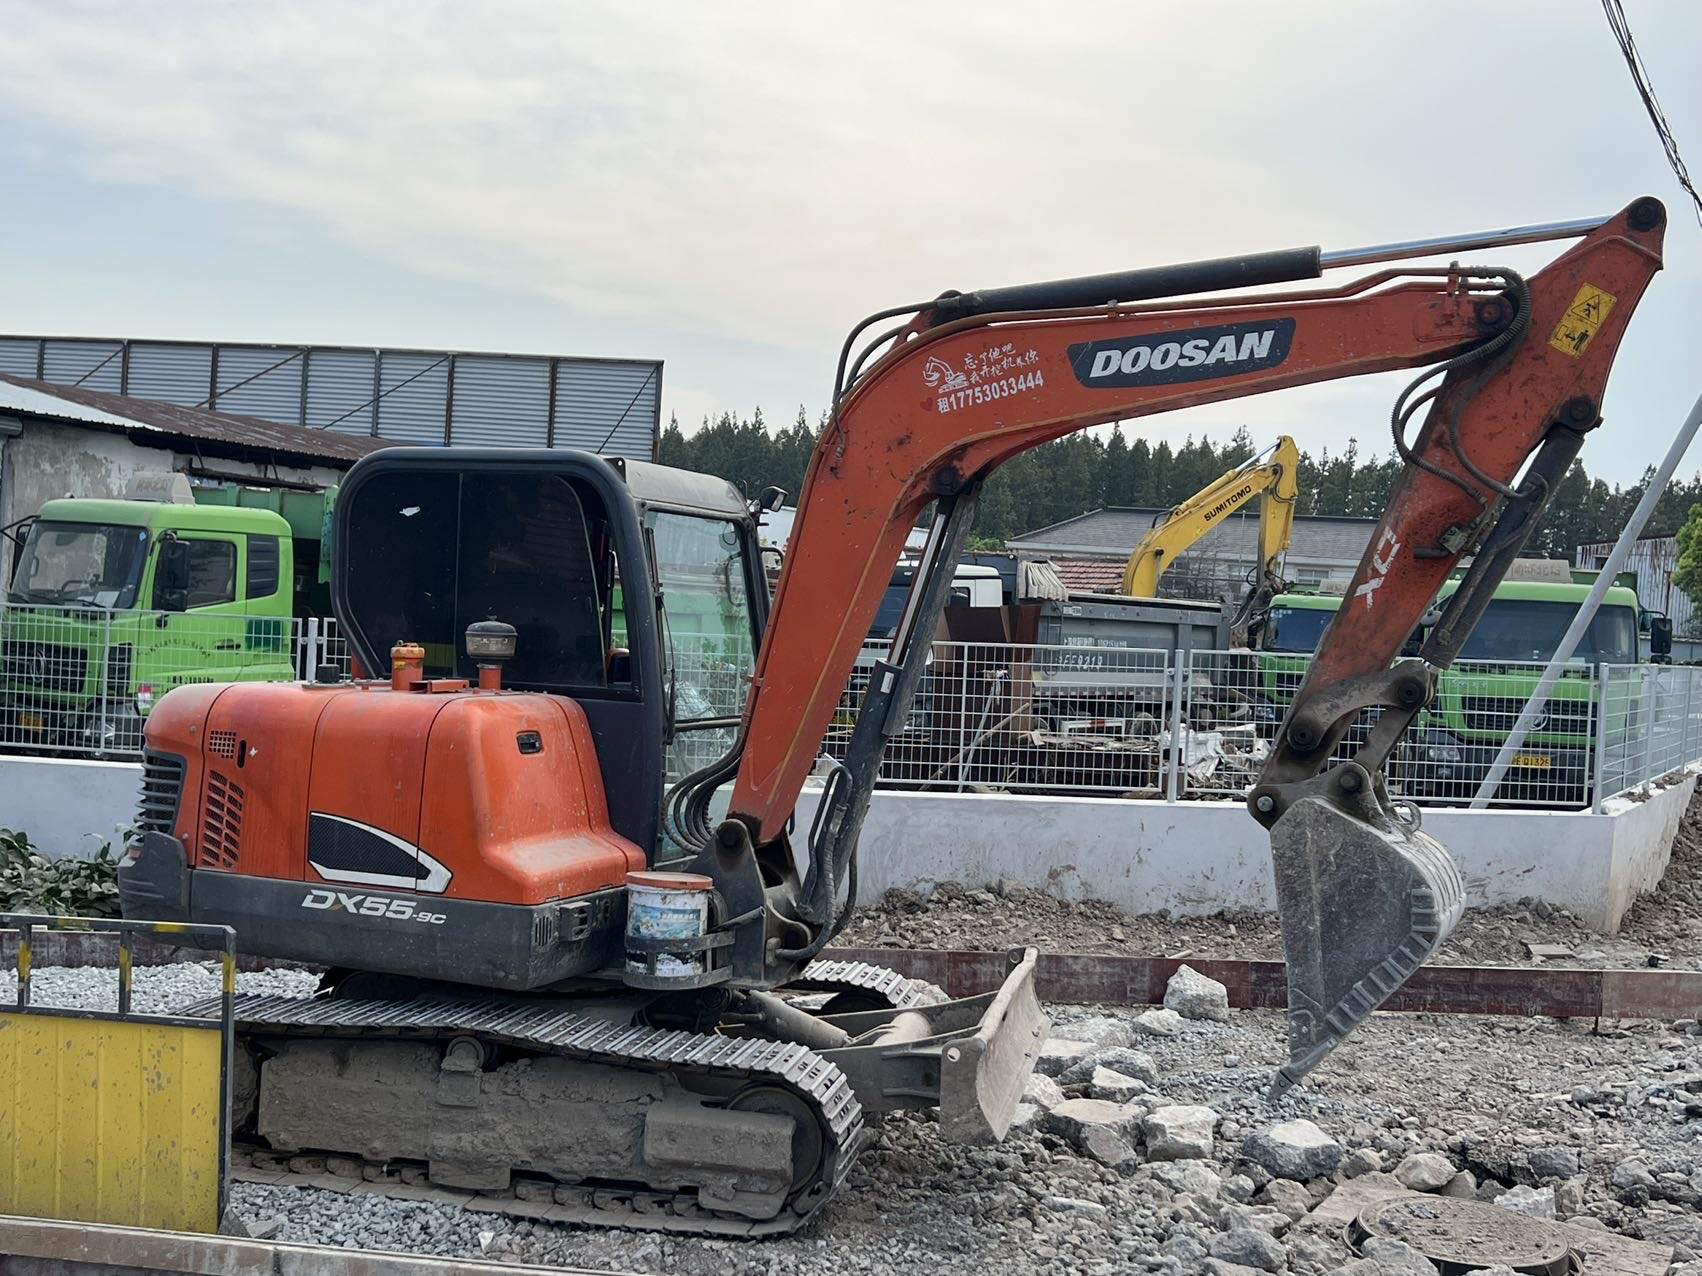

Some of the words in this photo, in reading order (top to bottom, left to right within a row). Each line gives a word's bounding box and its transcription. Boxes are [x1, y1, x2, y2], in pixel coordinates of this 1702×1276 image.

[1089, 330, 1275, 378] DOOSAN
[1203, 485, 1252, 521] SUMITOMO
[301, 889, 447, 925] DX55-9C
